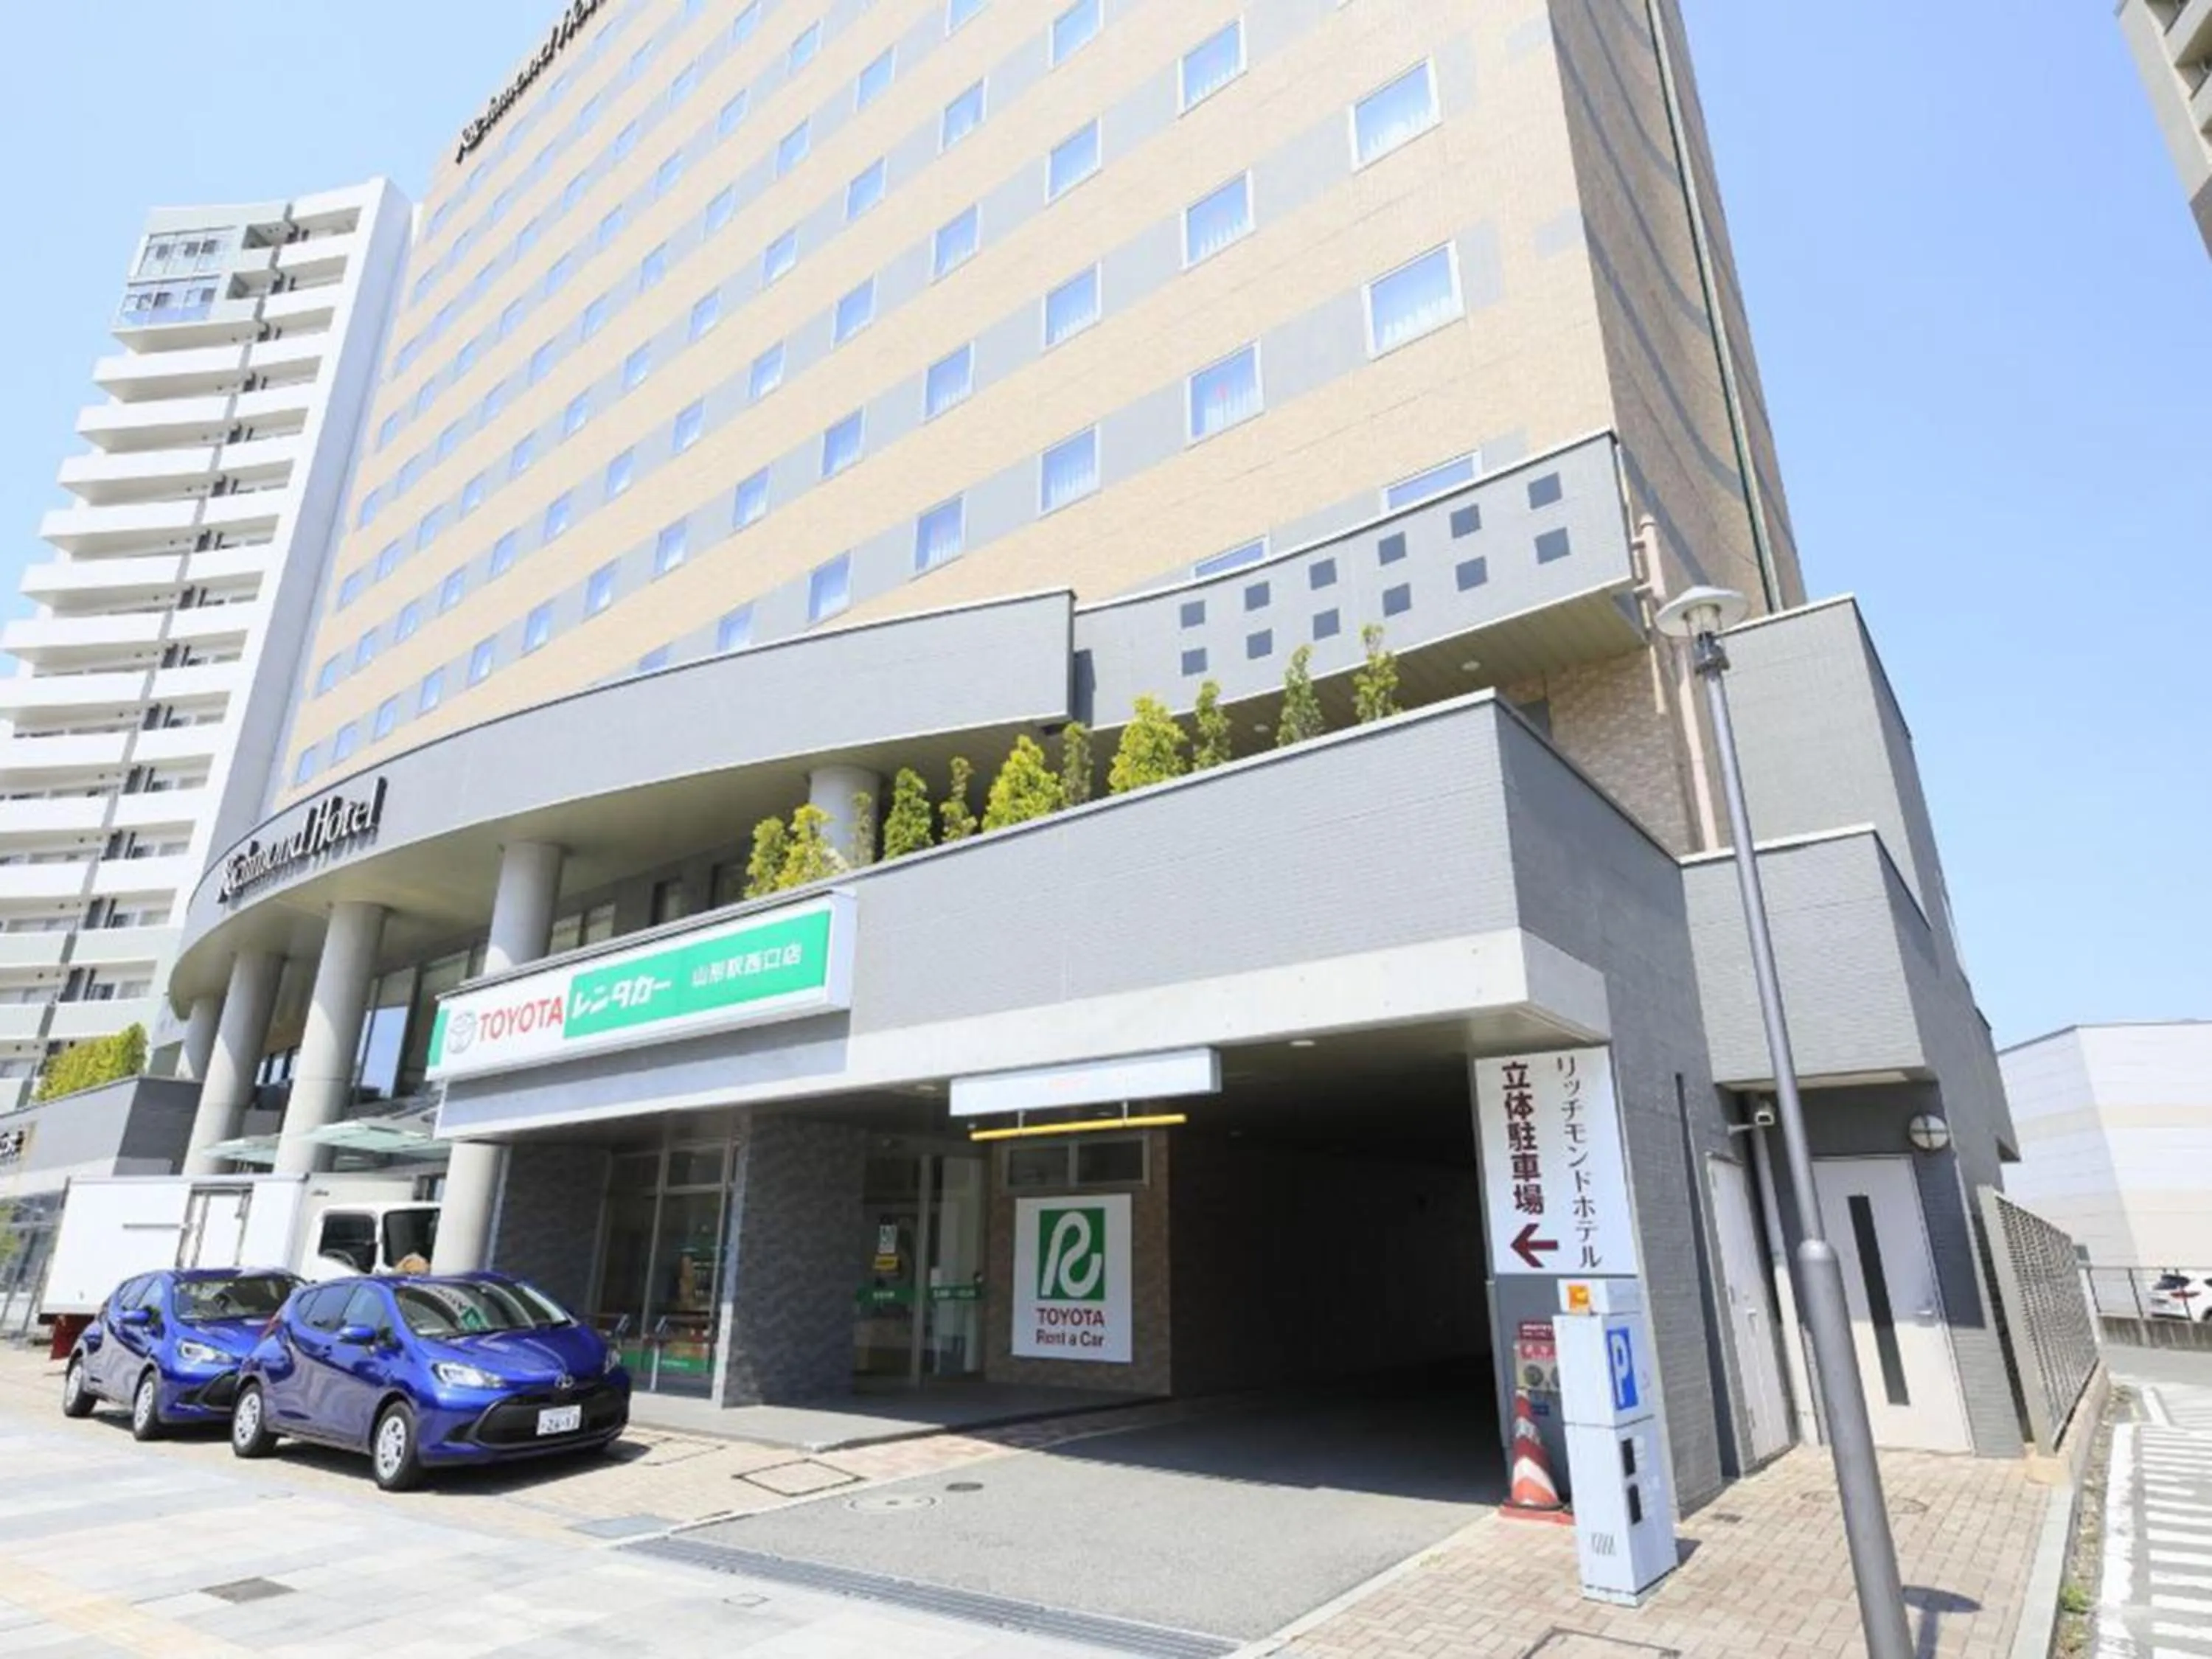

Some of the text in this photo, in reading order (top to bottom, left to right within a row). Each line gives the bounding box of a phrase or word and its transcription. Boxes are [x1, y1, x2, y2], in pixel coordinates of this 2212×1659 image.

[306, 776, 388, 855] Hotel
[571, 942, 802, 1019] レンタカー 山形駅西口店
[480, 996, 563, 1043] TOYOTA
[1502, 1062, 1544, 1214] 立体駐車場
[1557, 1057, 1602, 1268] リッチモンドホテル
[1036, 1307, 1105, 1326] TOYOTA
[1036, 1329, 1104, 1348] Rent a Car
